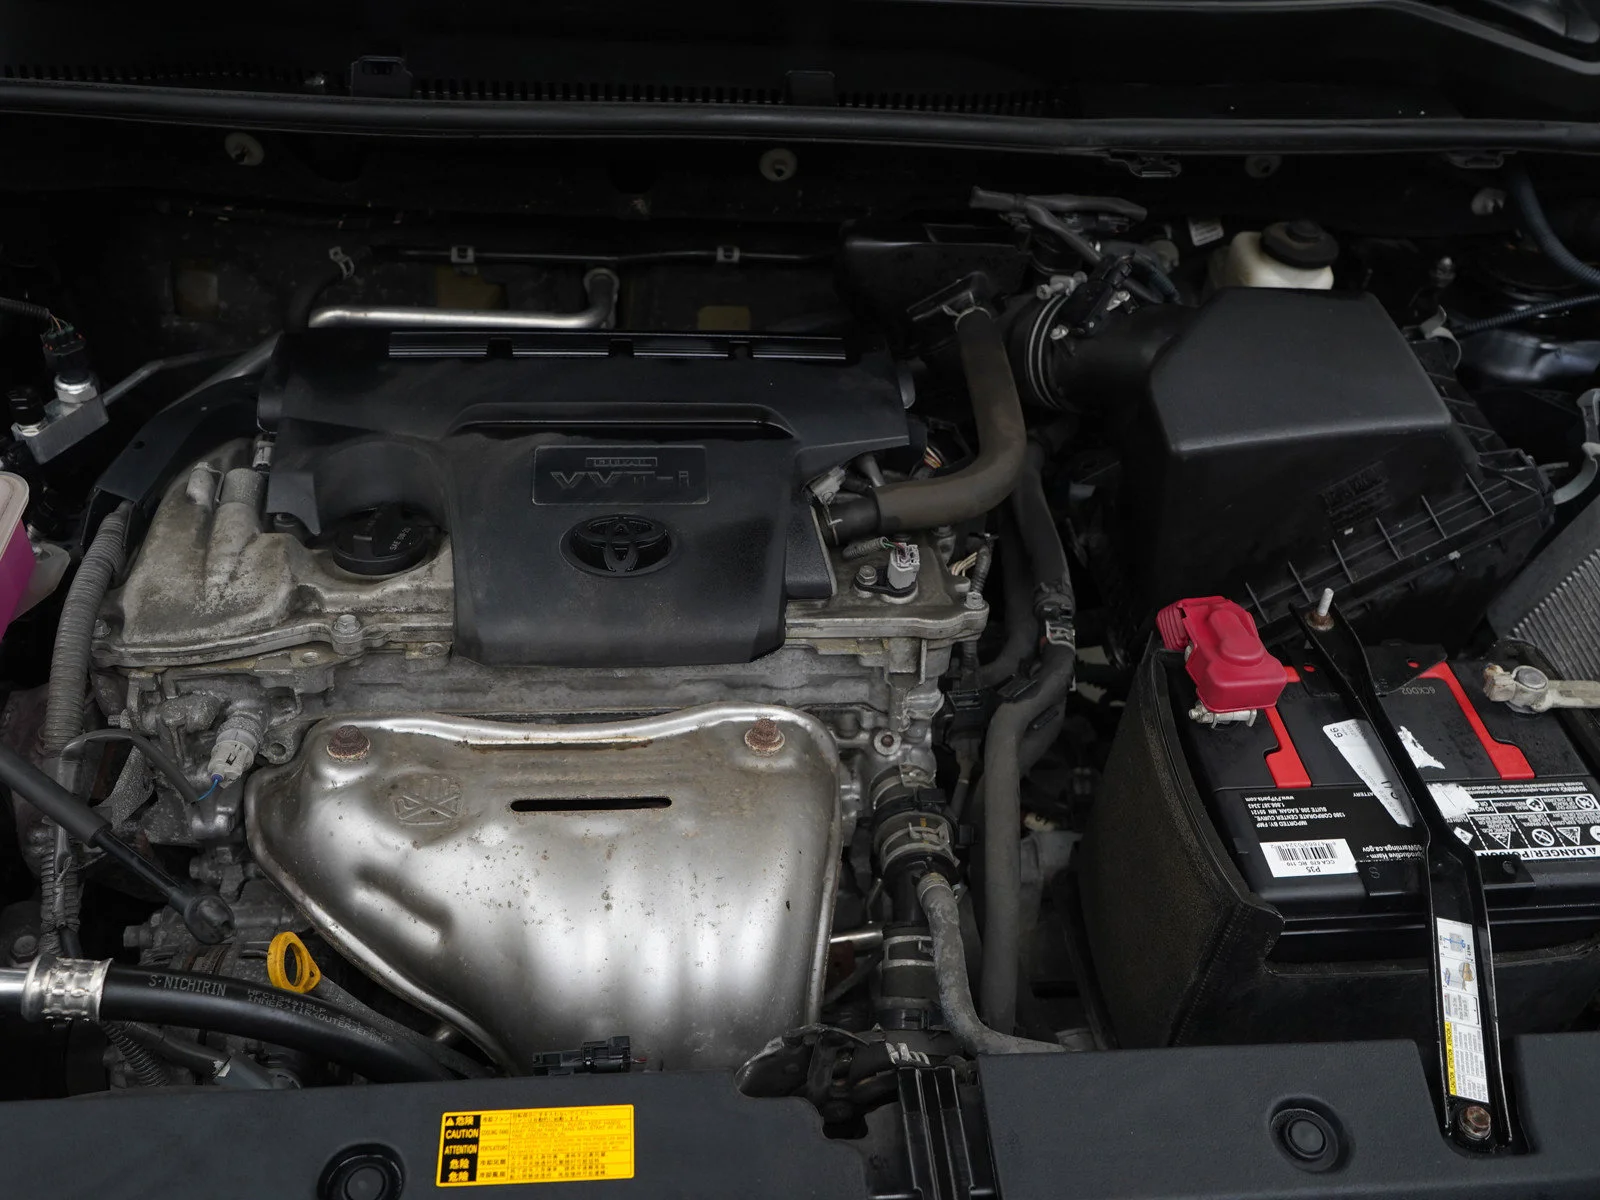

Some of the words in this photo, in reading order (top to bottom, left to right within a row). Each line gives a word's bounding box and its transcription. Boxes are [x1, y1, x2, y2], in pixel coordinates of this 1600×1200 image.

[1401, 686, 1436, 695] 6CKD02
[1362, 844, 1422, 852] 65Warnings.ca.gov
[1388, 851, 1424, 859] productive
[445, 1128, 479, 1139] CAUTION
[444, 1144, 478, 1155] ATTENTION
